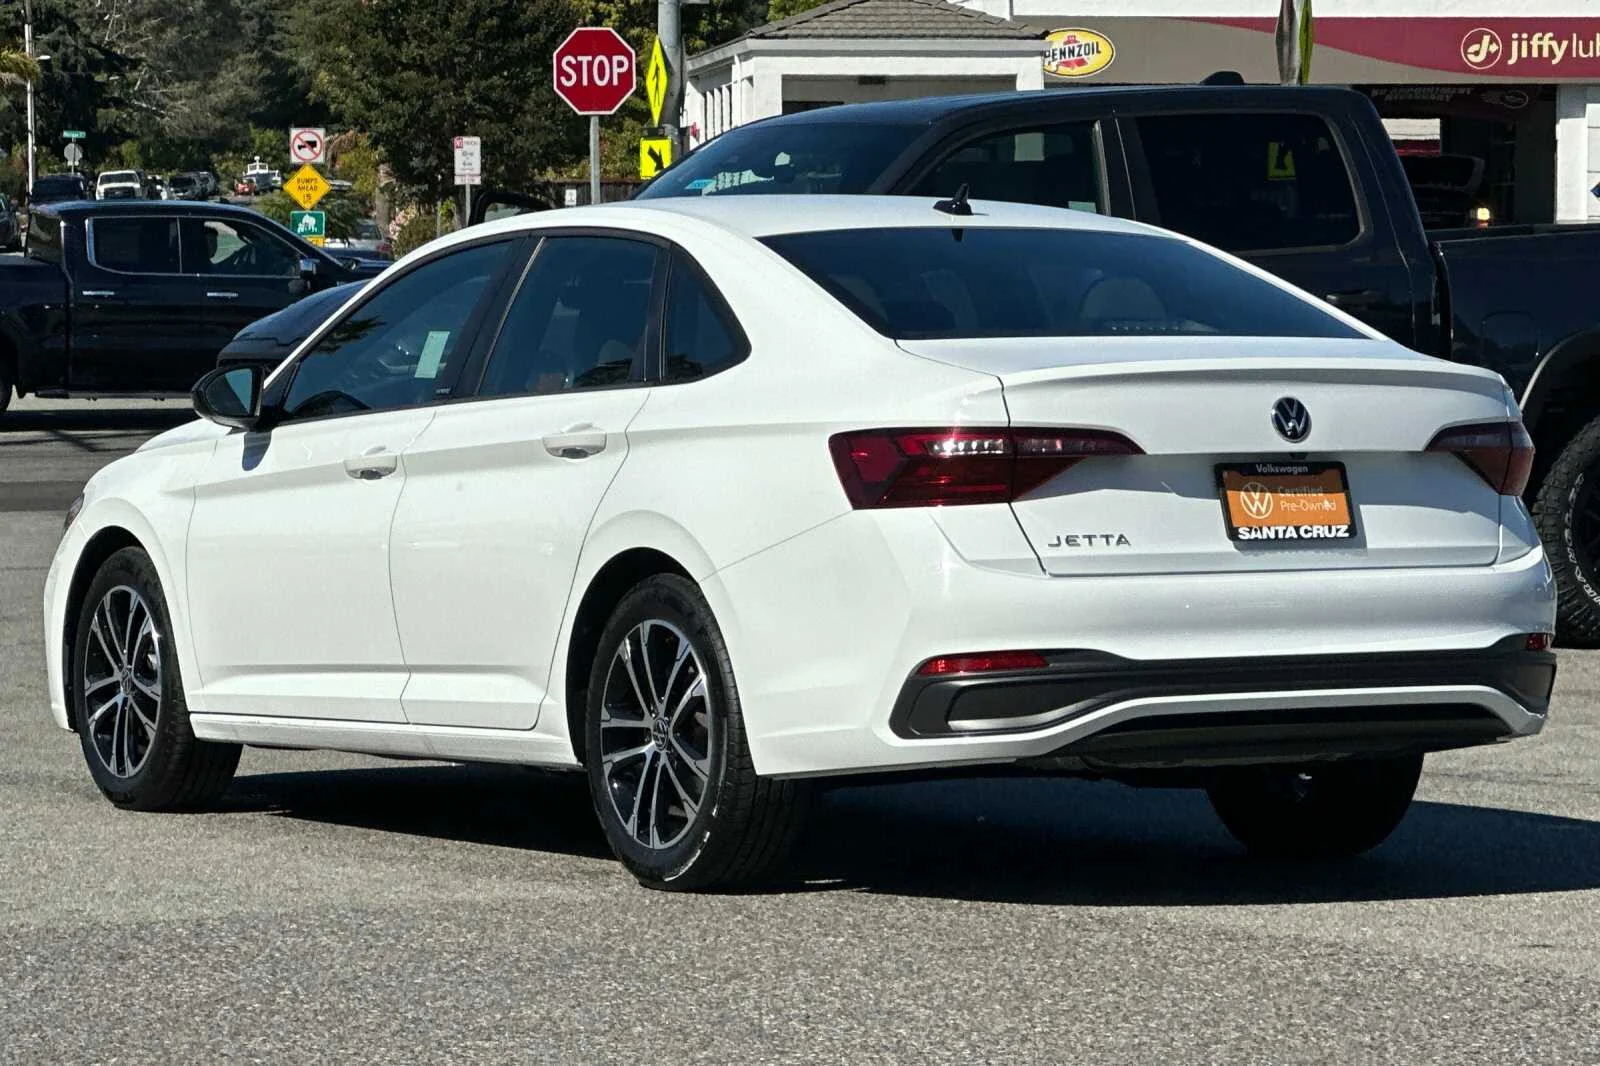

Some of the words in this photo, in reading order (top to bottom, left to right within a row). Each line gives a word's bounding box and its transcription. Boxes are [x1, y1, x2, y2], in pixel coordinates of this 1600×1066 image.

[1043, 41, 1101, 63] PENNZOIL
[560, 55, 629, 87] STOP
[1256, 463, 1308, 474] Volkswagen
[1278, 485, 1324, 497] Certified
[1280, 500, 1337, 512] Pre-Owned
[1238, 526, 1298, 540] SANTA
[1300, 525, 1349, 538] CRUZ
[1047, 533, 1132, 548] JETTA
